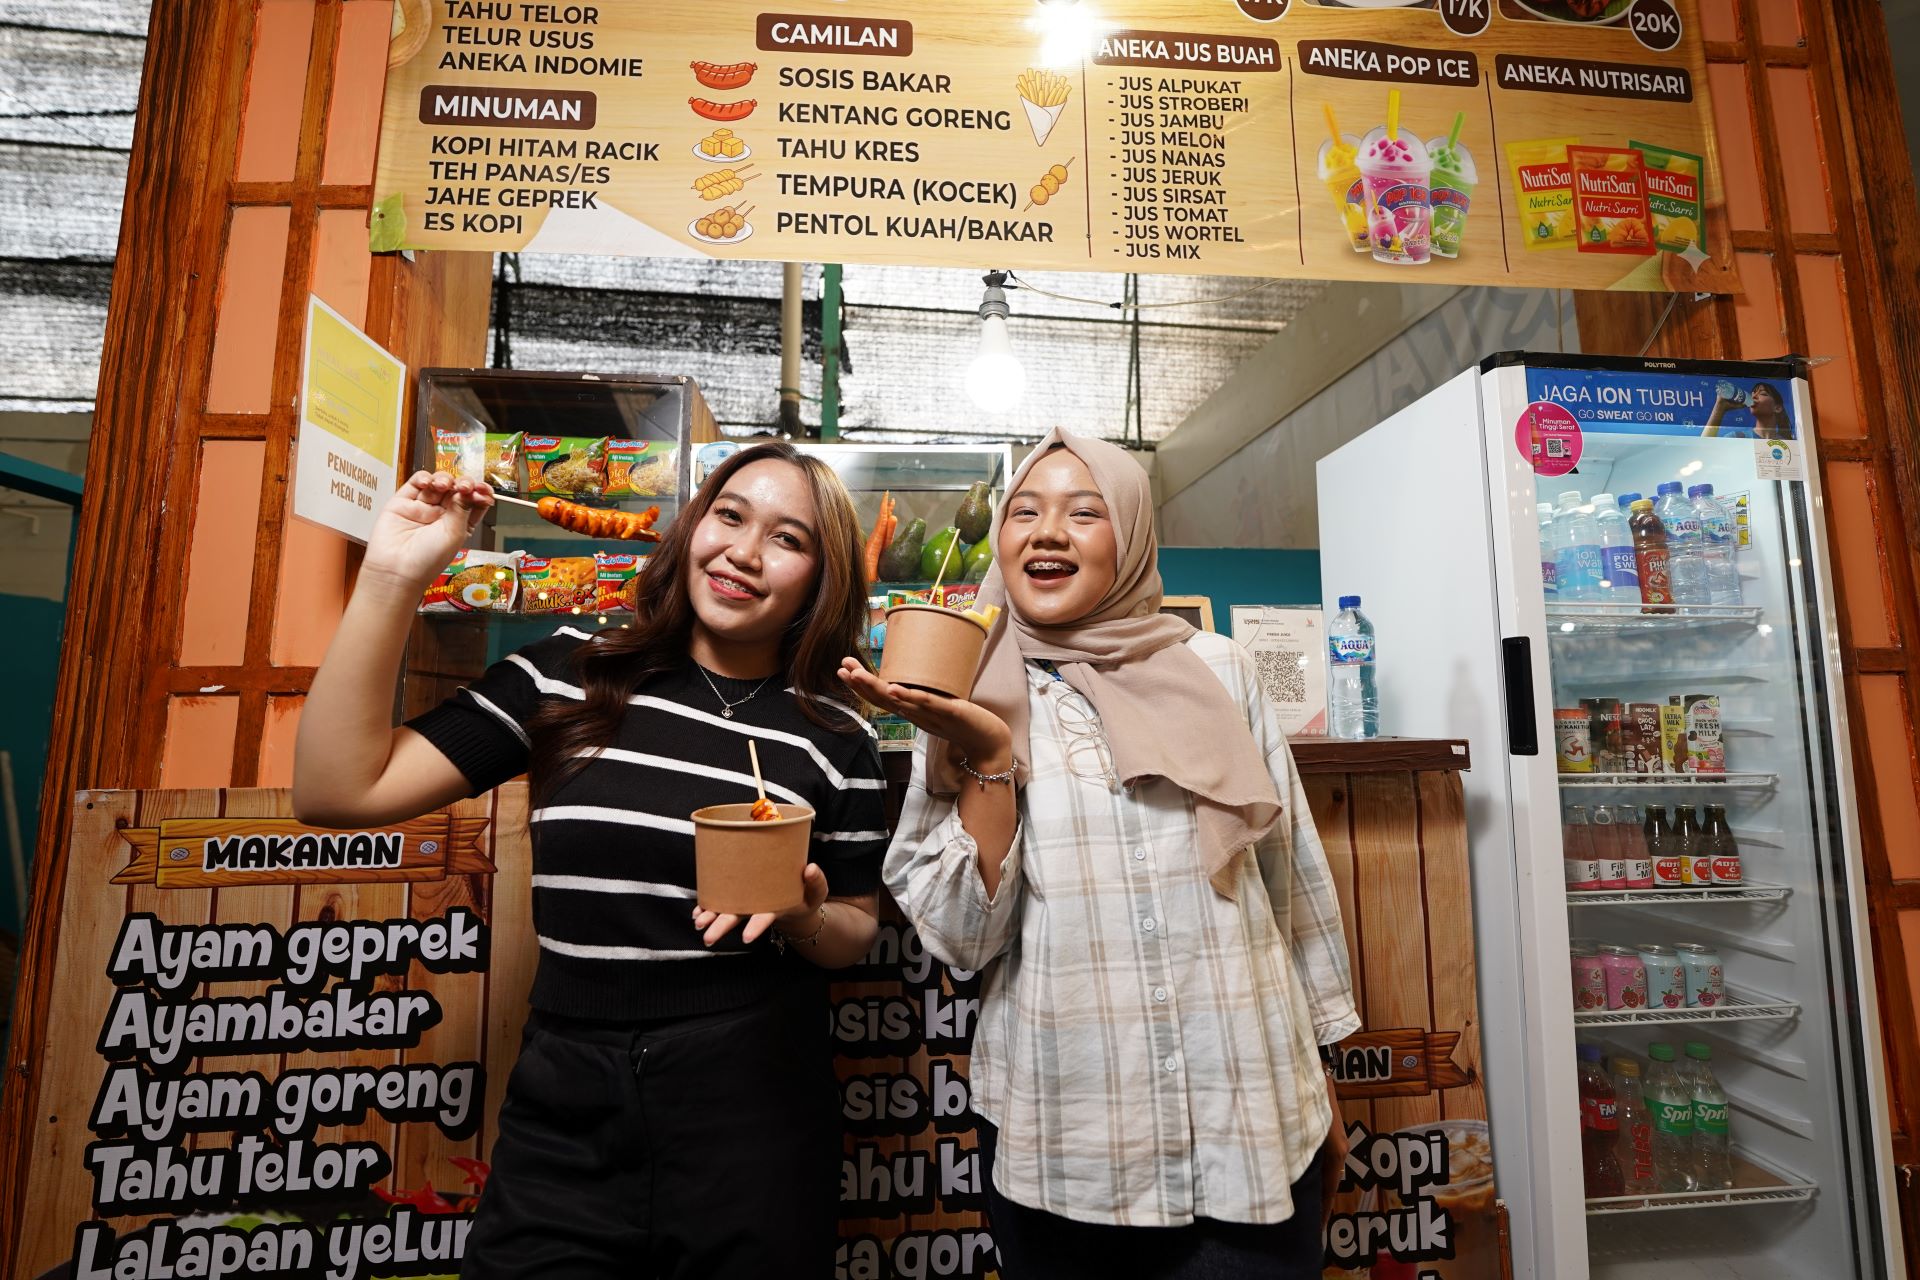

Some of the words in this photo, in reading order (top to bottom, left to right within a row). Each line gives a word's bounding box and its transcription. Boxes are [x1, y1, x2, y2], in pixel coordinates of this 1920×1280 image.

[445, 1, 512, 20] TAHU
[520, 4, 598, 24] TELOR
[1633, 12, 1678, 34] 20K
[442, 26, 521, 46] TELUR
[529, 30, 594, 49] USUS
[771, 22, 898, 48] CAMILAN
[1099, 38, 1170, 60] ANEKA
[1174, 41, 1212, 62] JUS
[1217, 45, 1274, 65] BUAH
[438, 52, 527, 73] ANEKA
[535, 55, 643, 77] INDOMIE
[1309, 48, 1382, 73] ANEKA
[1386, 54, 1431, 76] POP
[1437, 58, 1471, 79] ICE
[779, 66, 854, 89] SOSIS
[863, 71, 951, 93] BAKAR
[1119, 76, 1153, 91] JUS
[1158, 78, 1242, 94] ALPUKAT
[1504, 63, 1576, 86] ANEKA
[1580, 69, 1686, 95] NUTRISARI
[434, 95, 581, 121] MINUMAN
[1120, 95, 1154, 110] JUS
[1159, 96, 1249, 113] STROBERI
[779, 102, 898, 126] KENTANG
[906, 107, 1011, 130] GORENG
[1121, 113, 1154, 128] JUS
[1160, 114, 1224, 130] JAMBU
[431, 136, 491, 156] KOPI
[499, 138, 577, 158] HITAM
[585, 142, 660, 161] RACIK
[777, 138, 846, 160] TAHU
[855, 140, 920, 163] KRES
[1121, 131, 1155, 146] JUS
[1161, 132, 1225, 149] MELON
[1122, 149, 1156, 164] JUS
[1162, 150, 1226, 168] NANAS
[429, 161, 477, 181] TEH
[485, 163, 611, 185] PANAS/ES
[1123, 167, 1157, 183] JUS
[1162, 169, 1221, 186] JERUK
[1580, 172, 1637, 195] NutriSari
[425, 187, 490, 206] JAHE
[498, 189, 598, 210] GEPREK
[776, 174, 905, 200] TEMPURA
[913, 178, 1017, 209] (KOCEK)
[1123, 187, 1157, 203] JUS
[1163, 188, 1226, 205] SIRSAT
[424, 213, 454, 232] ES
[462, 214, 522, 234] KOPI
[1124, 206, 1158, 221] JUS
[1163, 207, 1228, 223] TOMAT
[777, 212, 878, 236] PENTOL
[886, 215, 1053, 243] KUAH/BAKAR
[1125, 224, 1159, 240] JUS
[1165, 225, 1244, 243] WORTEL
[1126, 243, 1160, 258] JUS
[1166, 244, 1201, 260] MIX
[1539, 384, 1592, 403] JAGA
[1597, 387, 1632, 405] ION
[1636, 388, 1704, 407] TUBUH
[1578, 409, 1595, 420] GO
[1597, 410, 1633, 421] SWEAT
[1636, 411, 1652, 421] GO
[1654, 412, 1674, 422] ION
[327, 452, 378, 491] PENUKARAN
[330, 478, 354, 504] MEAL
[1340, 639, 1369, 651] AQUA
[205, 833, 402, 871] MAKANAN
[113, 917, 273, 989] Ayam
[286, 912, 478, 985] geprek
[96, 1068, 261, 1140] Ayam
[275, 1066, 474, 1134] goreng
[92, 1144, 224, 1204] Tahu
